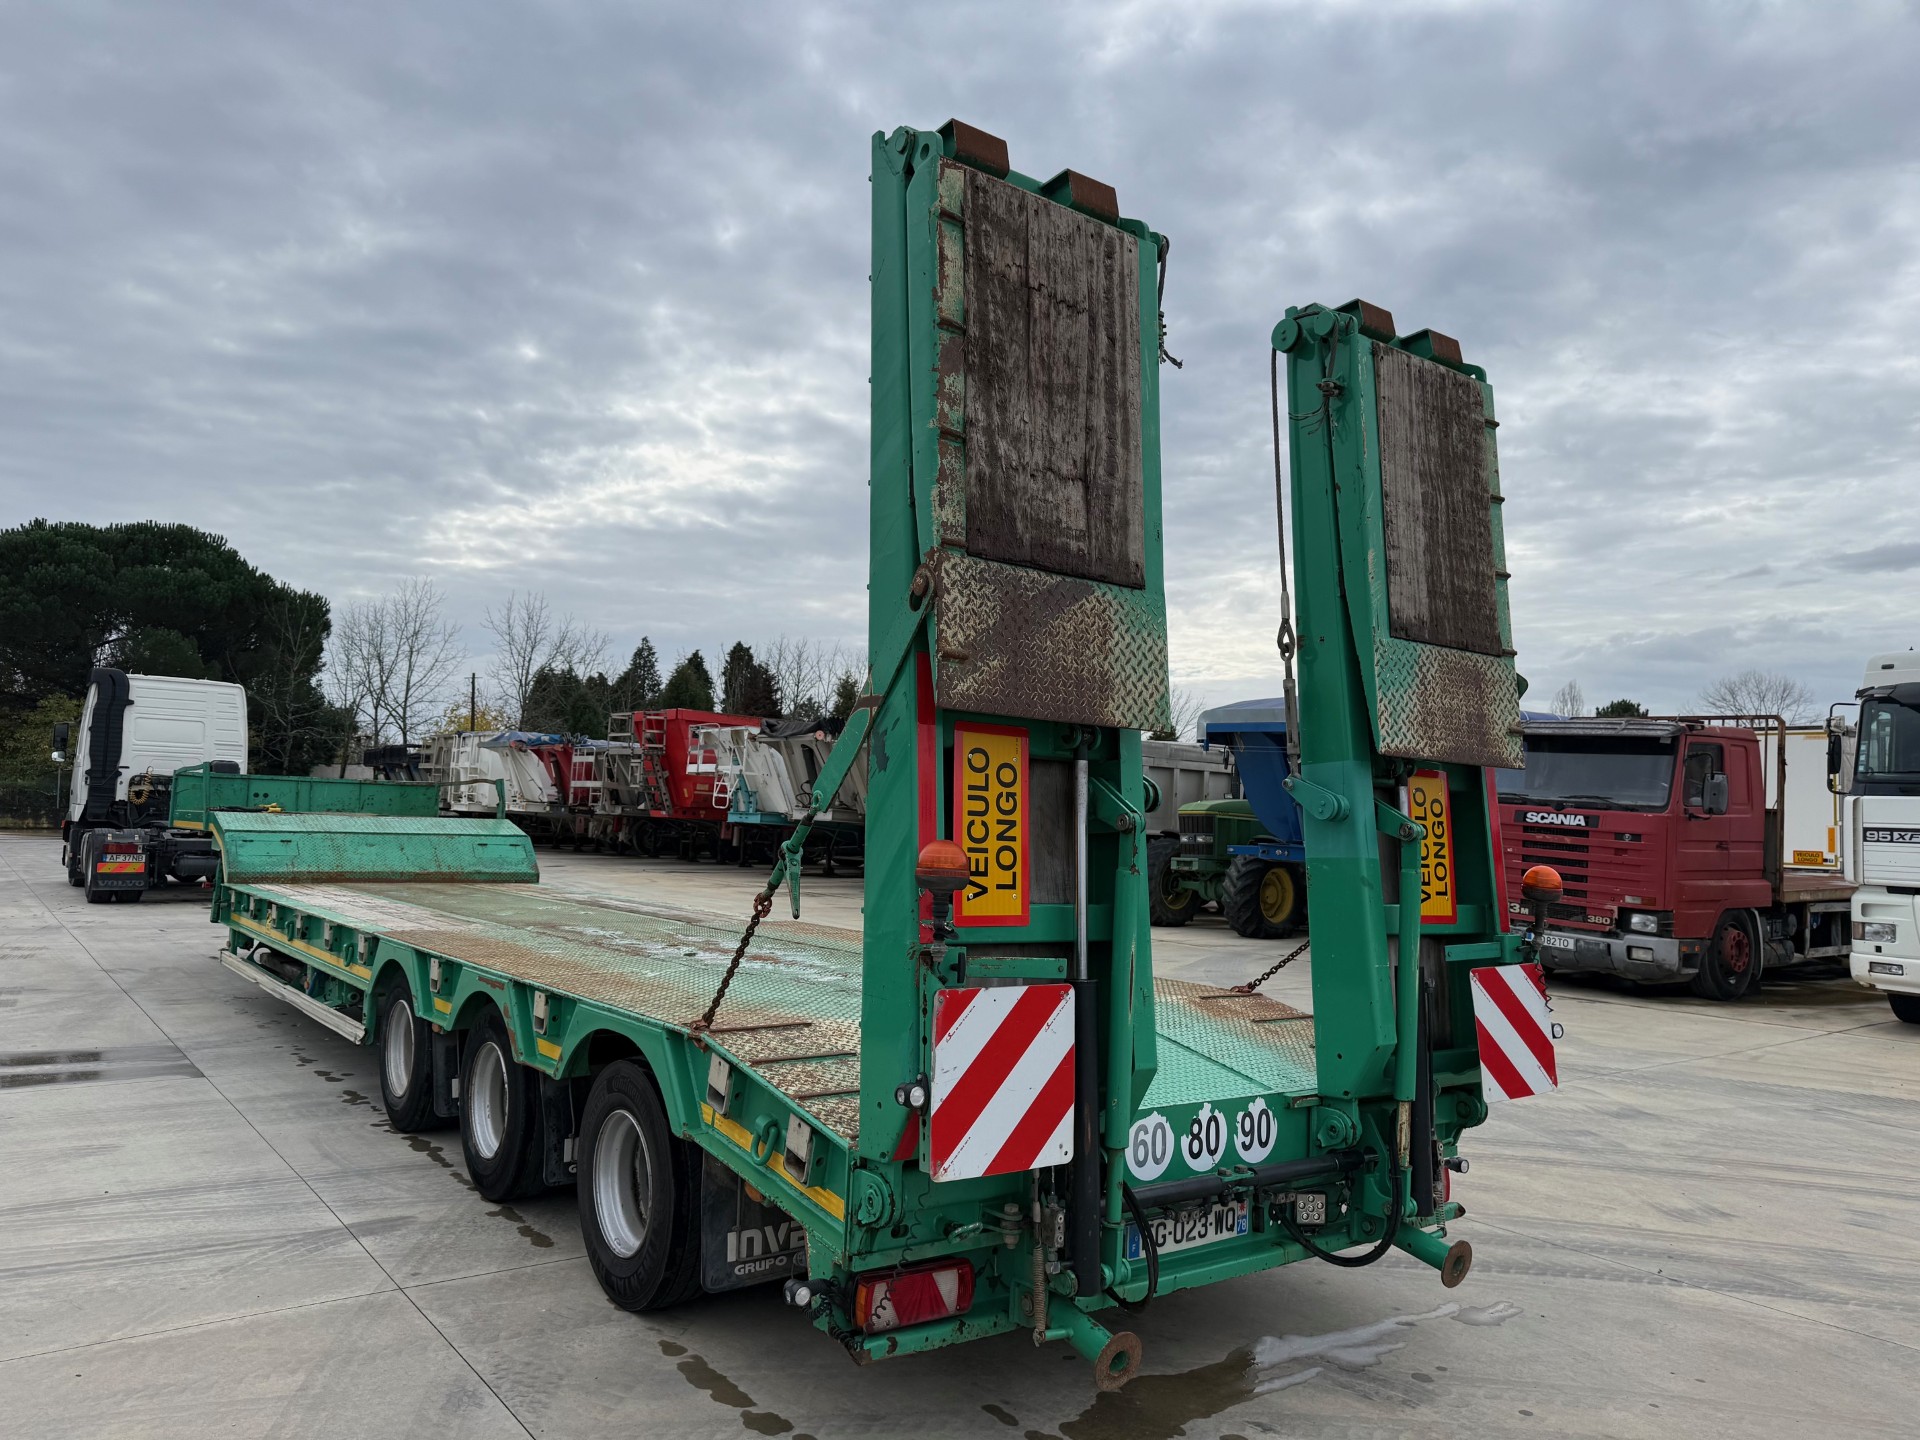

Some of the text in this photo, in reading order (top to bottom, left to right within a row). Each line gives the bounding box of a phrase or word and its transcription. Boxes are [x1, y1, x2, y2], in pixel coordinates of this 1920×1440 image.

[967, 747, 990, 902] VEICULO
[996, 762, 1018, 890] LONGO
[1525, 812, 1586, 826] SCANIA
[1866, 830, 1920, 842] 95 XF
[1430, 798, 1449, 897] LONGO
[1587, 915, 1611, 925] 380
[1132, 1121, 1167, 1168] 60
[1188, 1114, 1220, 1160] 80
[1241, 1108, 1271, 1152] 90
[734, 1255, 788, 1276] GRUPO
